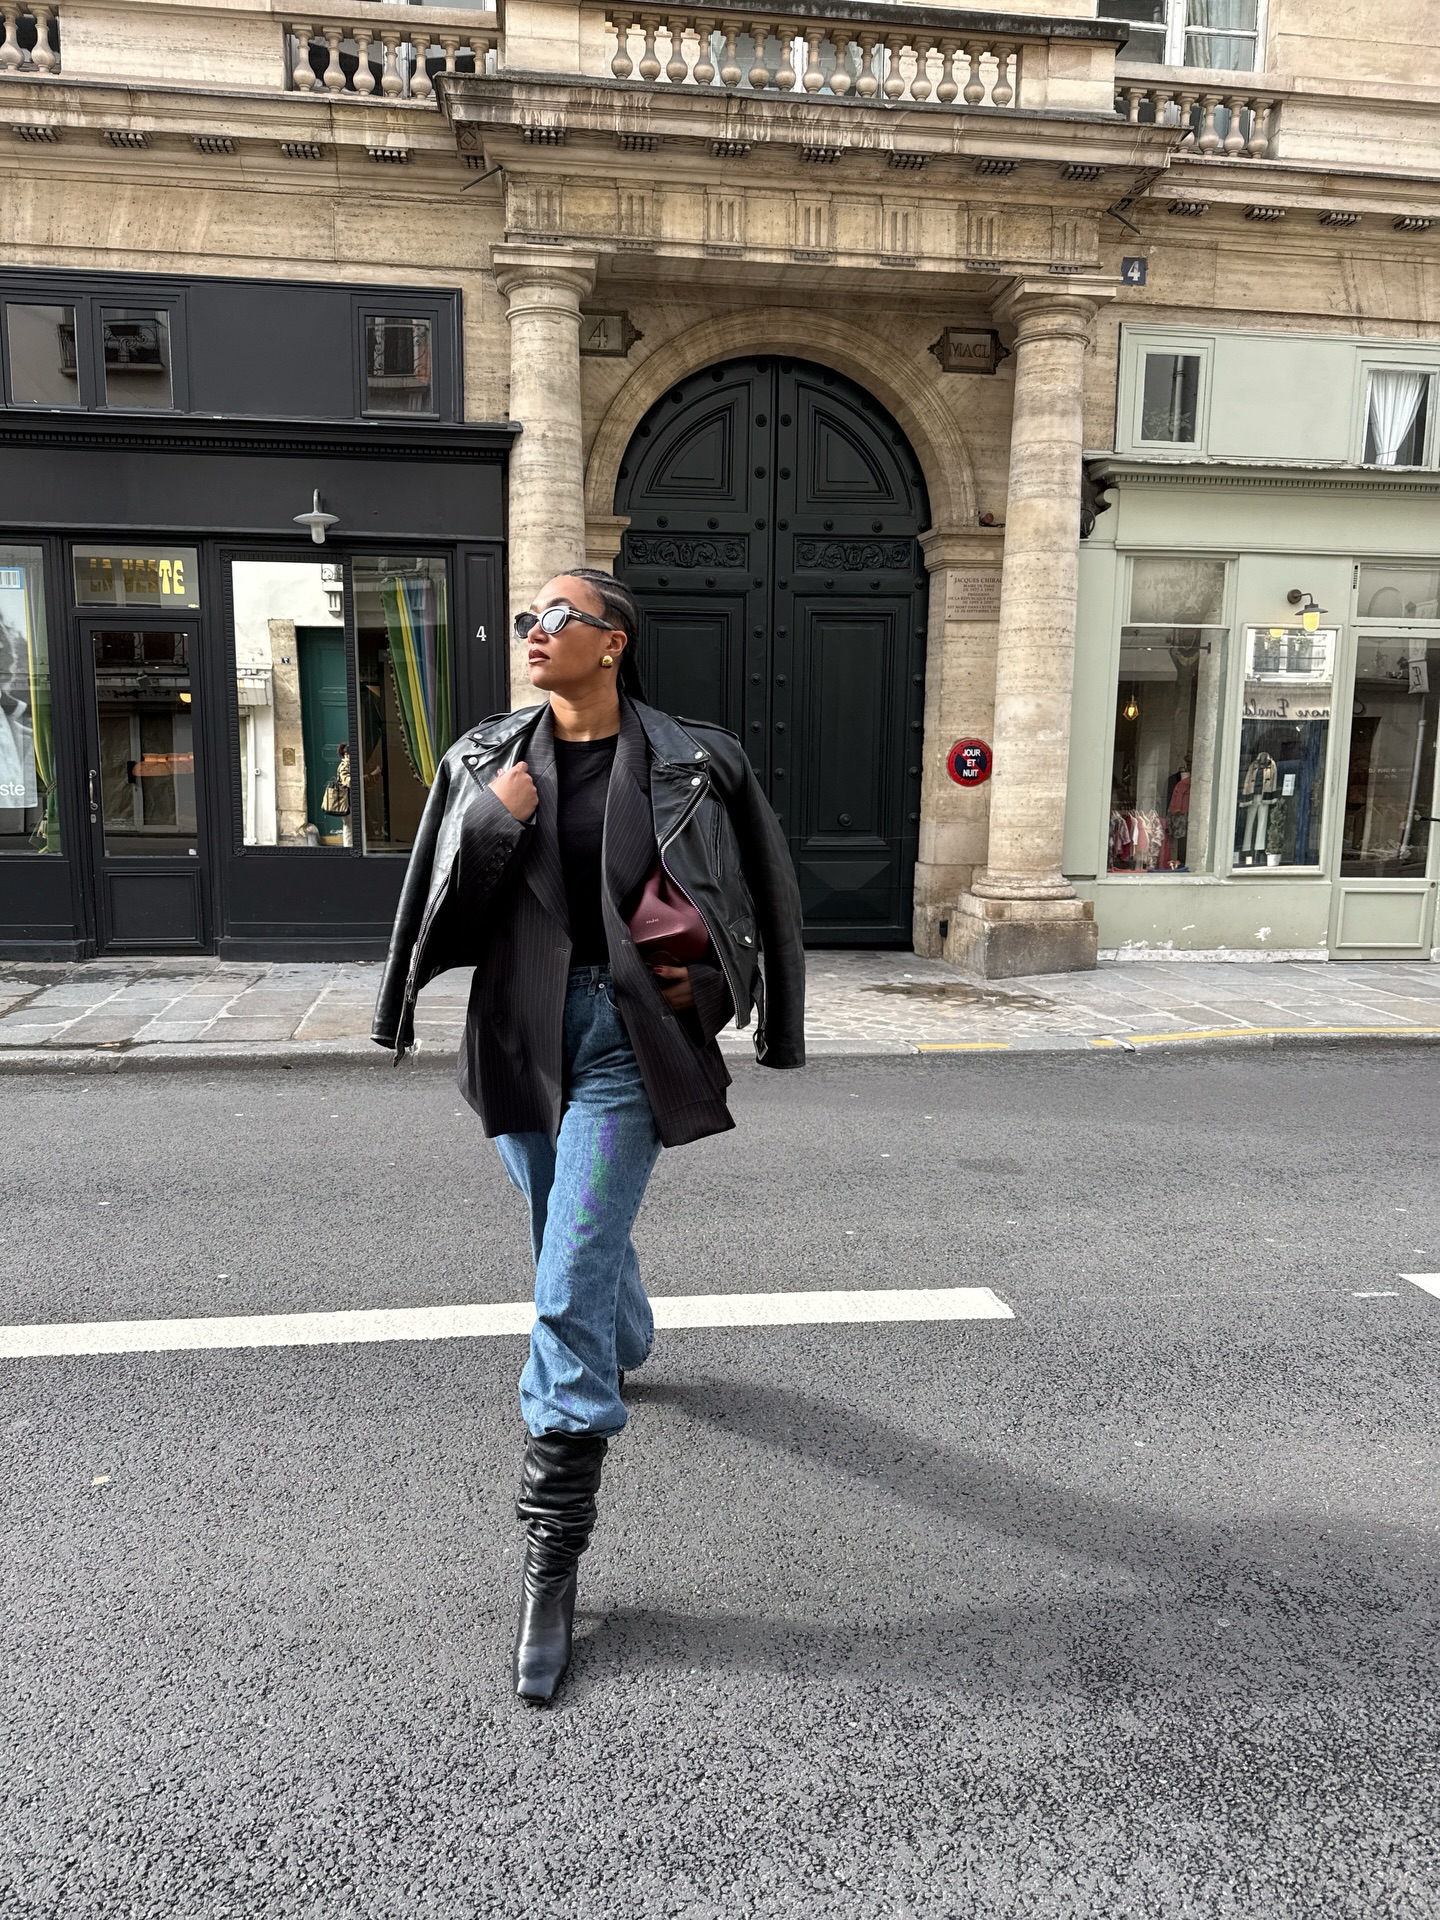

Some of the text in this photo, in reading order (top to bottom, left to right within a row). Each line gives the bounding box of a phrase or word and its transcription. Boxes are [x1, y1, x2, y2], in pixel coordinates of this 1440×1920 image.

[1127, 260, 1140, 281] 4
[588, 318, 608, 348] 4
[476, 625, 487, 642] 4
[962, 748, 981, 757] JOUR
[966, 759, 976, 767] ET
[962, 769, 979, 777] NUIT
[0, 781, 26, 796] ste
